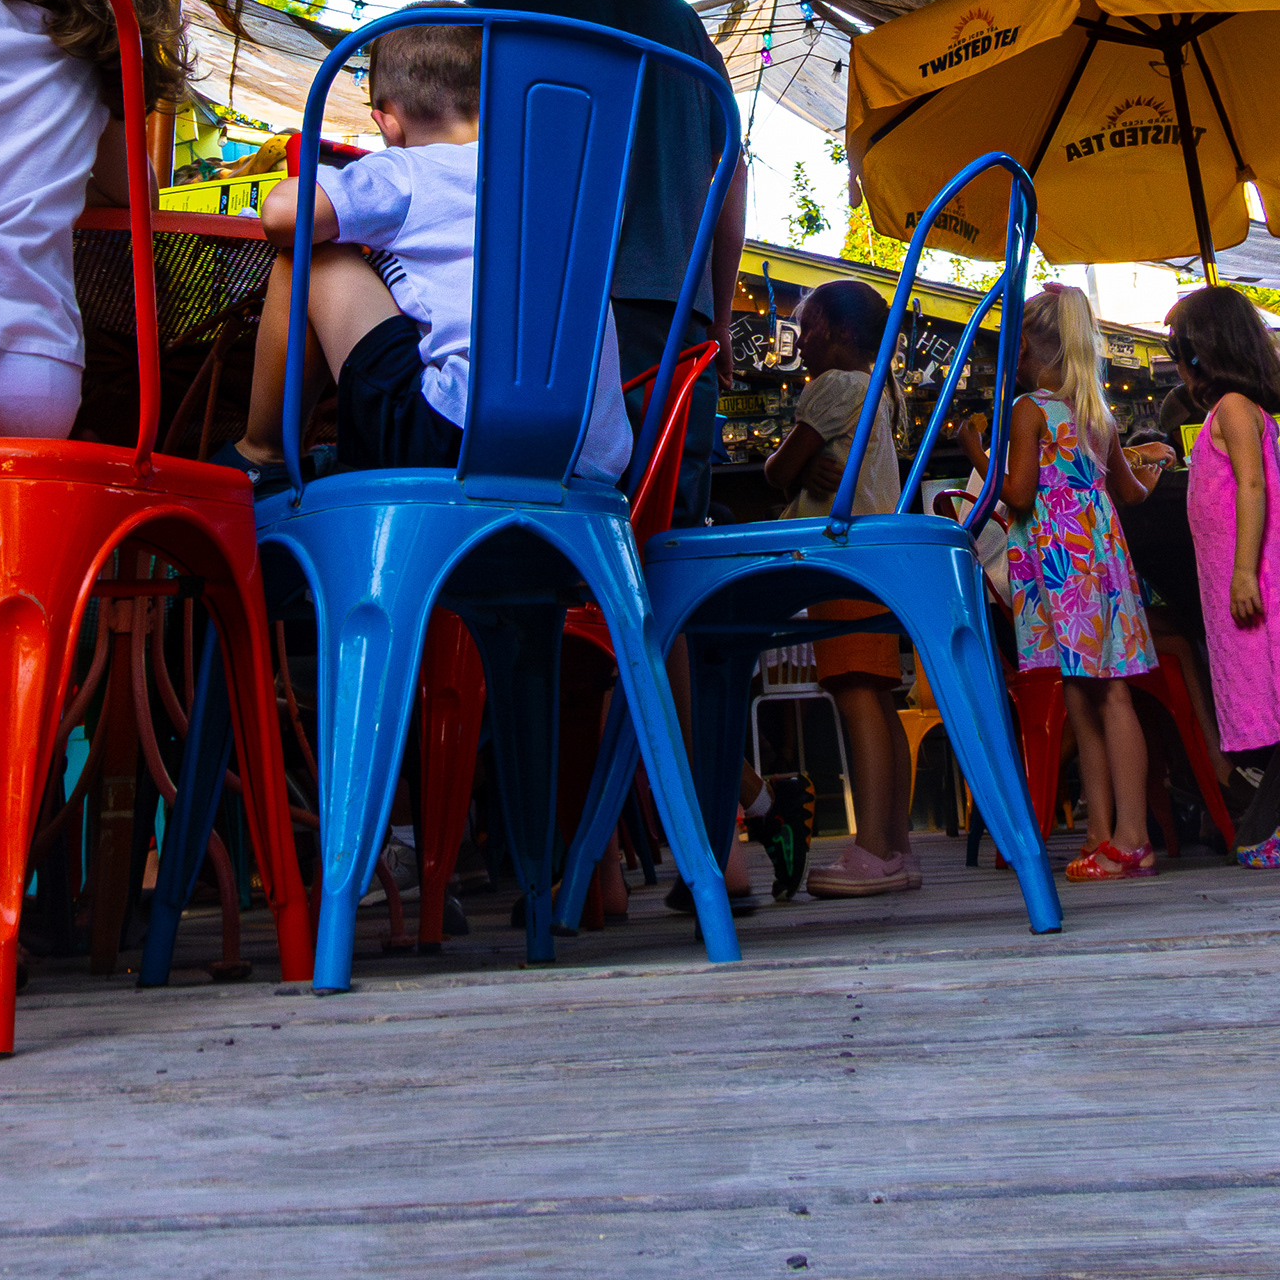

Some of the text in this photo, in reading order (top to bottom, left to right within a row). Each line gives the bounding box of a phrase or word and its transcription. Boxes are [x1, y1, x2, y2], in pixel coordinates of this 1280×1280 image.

[918, 25, 1021, 78] TWISTED TEA
[729, 315, 752, 340] ET
[733, 334, 770, 361] OUR
